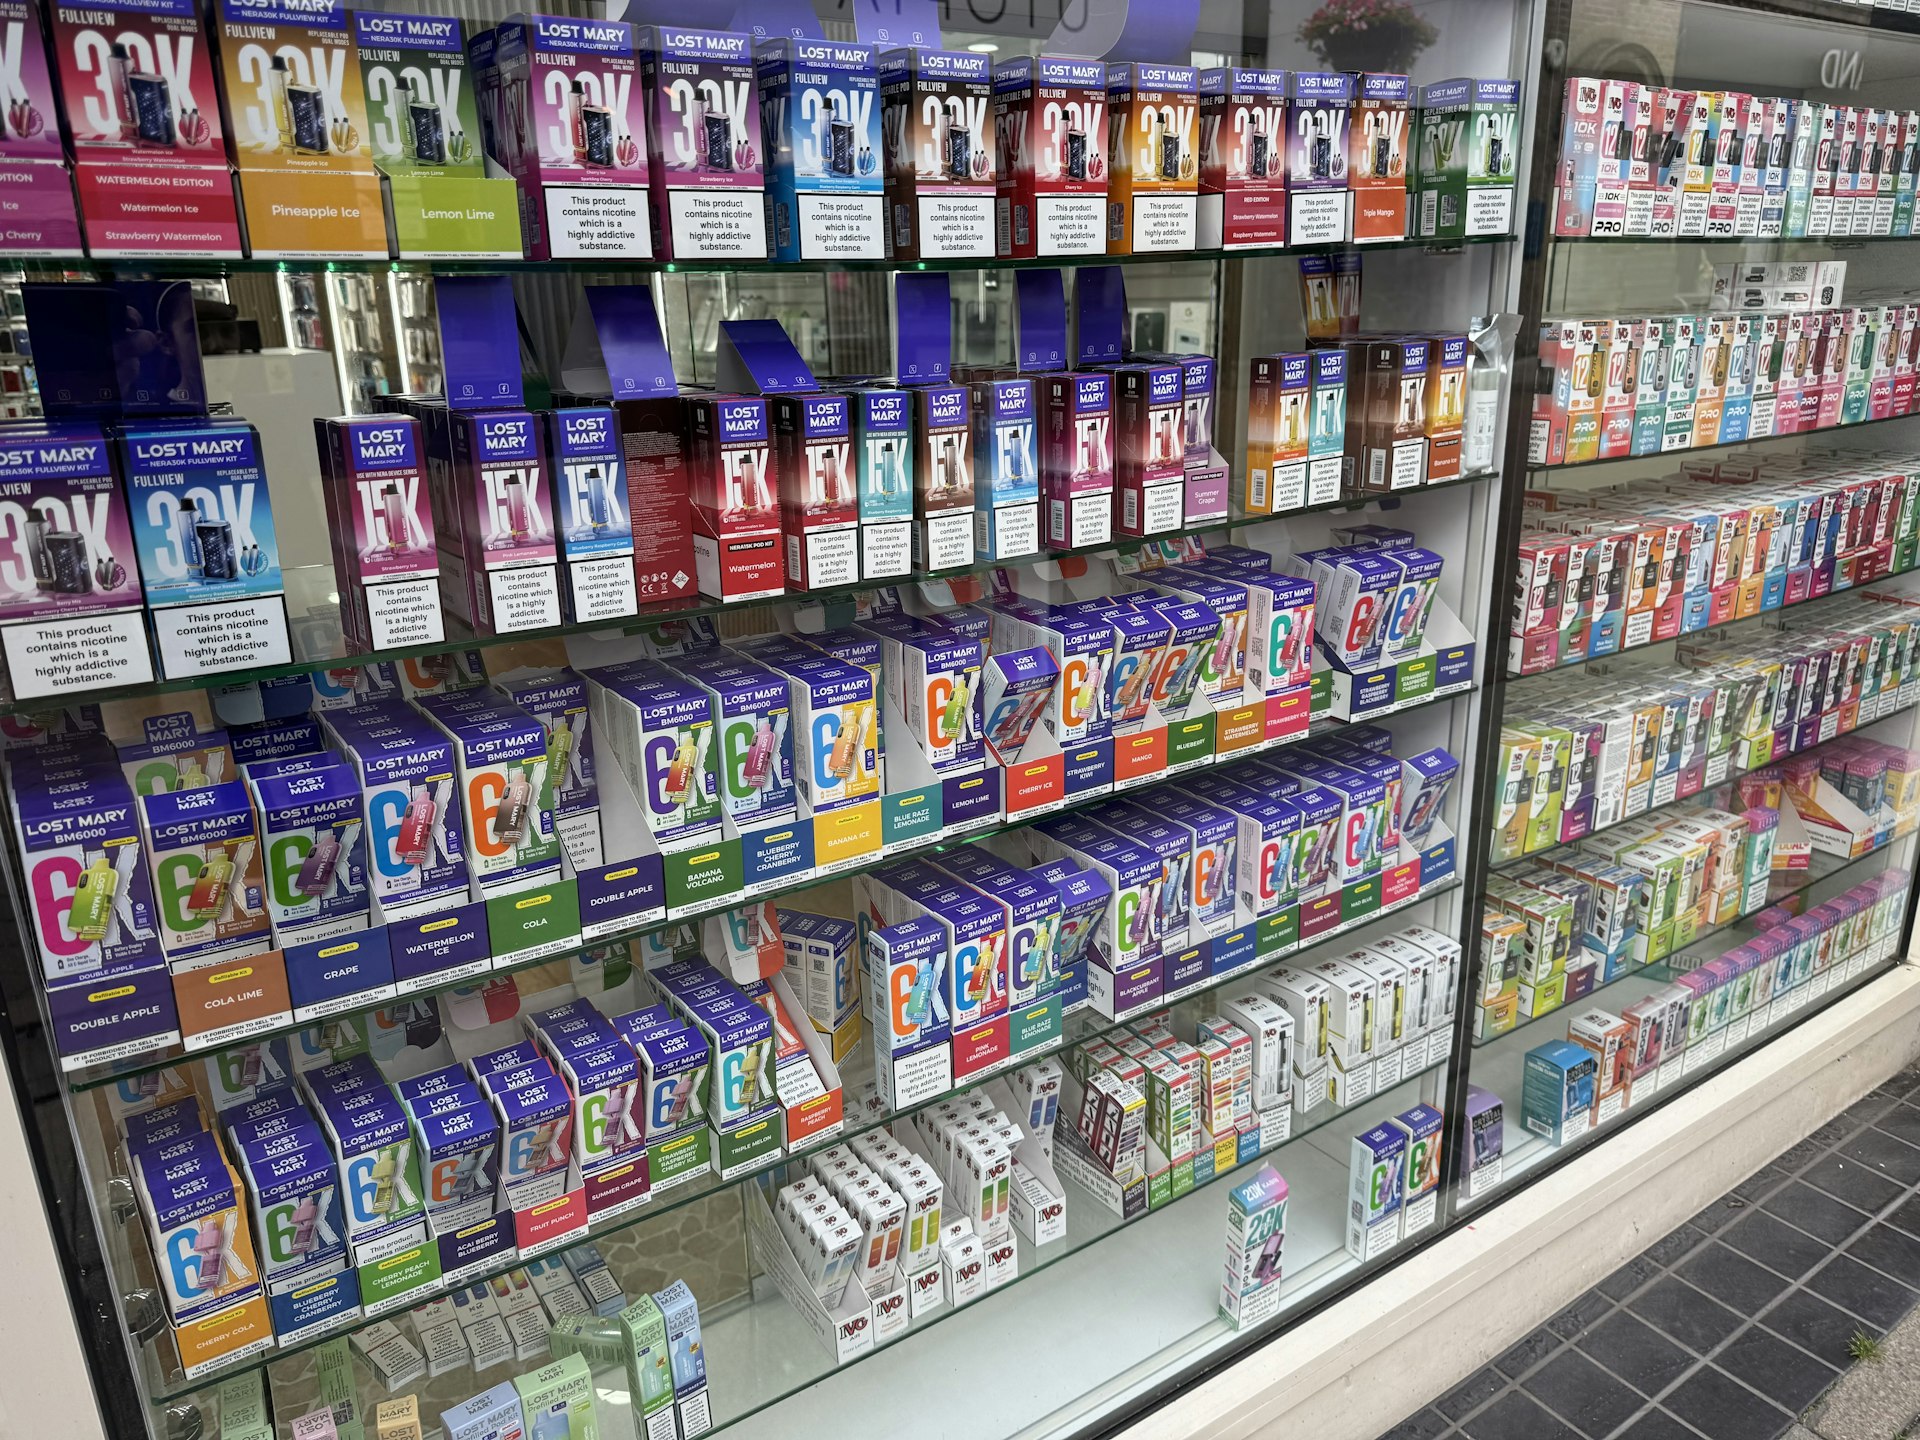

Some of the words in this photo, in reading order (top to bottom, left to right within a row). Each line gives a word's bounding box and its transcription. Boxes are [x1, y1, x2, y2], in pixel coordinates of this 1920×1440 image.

[59, 9, 115, 26] FULLVIEW
[151, 16, 182, 25] REPLACEABLE
[242, 10, 278, 19] NERA30K
[279, 13, 313, 22] FULLVIEW
[315, 15, 329, 23] KIT
[181, 25, 198, 33] MODES
[539, 22, 579, 38] LOST
[583, 27, 625, 43] MARY
[549, 40, 577, 48] NERA30K
[579, 42, 607, 50] FULLVIEW
[666, 34, 703, 49] LOST
[707, 38, 744, 52] MARY
[1043, 65, 1070, 78] LOST
[1074, 66, 1100, 78] MARY
[1235, 73, 1257, 83] LOST
[1259, 75, 1281, 85] MARY
[1427, 88, 1446, 98] LOST
[1448, 86, 1467, 96] MARY
[1574, 122, 1597, 134] 10K
[96, 176, 170, 187] WATERMELON
[172, 178, 213, 188] EDITION
[121, 202, 182, 214] Watermelon
[184, 204, 199, 214] Ice
[272, 205, 338, 218] Pineapple
[341, 206, 360, 218] Ice
[422, 208, 462, 220] Lemon
[466, 209, 495, 220] Lime
[1364, 208, 1376, 218] Triple
[1378, 208, 1395, 217] Mango
[1233, 213, 1254, 221] Strawberry
[1254, 213, 1278, 221] Watermelon
[1595, 222, 1622, 232] PRO
[1285, 361, 1306, 370] LOST
[1284, 369, 1306, 380] MARY
[1849, 390, 1866, 398] PRO
[870, 398, 902, 410] LOST
[1780, 401, 1798, 410] PRO
[724, 407, 759, 420] LOST
[870, 409, 902, 421] MARY
[566, 417, 605, 431] LOST
[725, 419, 760, 432] MARY
[1573, 421, 1597, 432] PRO
[1607, 418, 1630, 430] PRO
[567, 431, 607, 444] MARY
[137, 443, 188, 459] LOST
[192, 439, 244, 455] MARY
[1434, 458, 1448, 467] Banana
[1194, 489, 1220, 501] Summer
[1198, 496, 1216, 506] Grape
[514, 549, 538, 557] Lemonade
[729, 561, 776, 574] Watermelon
[747, 571, 759, 580] Ice
[1598, 572, 1609, 595] 12
[1567, 580, 1579, 602] 12
[37, 631, 62, 641] This
[66, 623, 112, 638] product
[26, 639, 77, 654] contains
[81, 633, 128, 648] nicotine
[50, 651, 85, 663] which
[88, 650, 97, 658] is
[102, 650, 109, 658] a
[35, 662, 71, 678] highly
[75, 658, 128, 672] addictive
[52, 671, 116, 687] substance.
[813, 685, 843, 698] LOST
[842, 678, 870, 692] MARY
[1359, 683, 1391, 696] STRAWBERRY
[1360, 689, 1390, 700] RASPBERRY
[827, 692, 857, 703] BM6000
[1359, 694, 1391, 706] BLACKBERRY
[1266, 714, 1297, 727] STRAWBERRY
[1299, 711, 1308, 719] ICE
[467, 741, 505, 756] LOST
[508, 732, 540, 748] MARY
[1176, 738, 1206, 751] BLUEBERRY
[1131, 752, 1153, 764] MANGO
[1018, 784, 1041, 795] CHERRY
[1041, 781, 1053, 791] ICE
[26, 817, 76, 836] LOST
[78, 808, 128, 827] MARY
[894, 812, 912, 822] BLUE
[913, 808, 930, 819] RAZZ
[894, 814, 930, 830] LEMONADE
[54, 827, 107, 845] BM6000
[686, 874, 724, 889] VOLCANO
[688, 868, 722, 882] BANANA
[522, 918, 548, 930] COLA
[1262, 932, 1279, 943] TRIPLE
[1280, 926, 1294, 936] BERRY
[406, 932, 475, 956] WATERMELON
[433, 945, 450, 956] ICE
[323, 964, 359, 981] GRAPE
[93, 990, 118, 1000] Refillable
[204, 996, 236, 1010] COLA
[238, 988, 264, 1003] LIME
[70, 1016, 121, 1033] DOUBLE
[122, 1004, 161, 1022] APPLE
[1020, 1025, 1037, 1036] BLUE
[1037, 1019, 1052, 1030] RAZZ
[1020, 1024, 1052, 1039] LEMONADE
[89, 1047, 127, 1059] FORBIDDEN
[138, 1038, 153, 1047] SELL
[912, 1039, 931, 1049] MENTHOL
[975, 1043, 989, 1053] PINK
[966, 1046, 999, 1063] LEMONADE
[800, 1107, 832, 1125] RASPBERRY
[807, 1114, 826, 1126] PEACH
[732, 1141, 751, 1155] TRIPLE
[752, 1134, 772, 1148] MELON
[592, 1185, 620, 1202] SUMMER
[621, 1178, 643, 1191] GRAPE
[1038, 1203, 1064, 1224] IVG
[530, 1221, 550, 1233] FRUIT
[551, 1211, 575, 1226] PUNCH
[456, 1241, 473, 1252] ACAI
[475, 1232, 498, 1246] BERRY
[457, 1238, 500, 1258] BLUEBERRY
[956, 1261, 982, 1283] IVG
[292, 1288, 340, 1309] BLUEBERRY
[302, 1298, 333, 1312] CHERRY
[876, 1294, 904, 1317] IVG
[294, 1300, 343, 1322] CRANBERRY
[623, 1300, 648, 1318] LOST
[627, 1304, 653, 1324] MARY
[196, 1330, 229, 1349] CHERRY
[231, 1322, 255, 1336] COLA
[839, 1317, 869, 1341] IVG
[849, 1332, 861, 1342] AIR
[538, 1365, 562, 1378] LOST
[540, 1369, 565, 1384] MARY
[526, 1387, 557, 1406] LOST
[558, 1376, 587, 1393] MARY
[528, 1400, 559, 1413] Prefilled
[561, 1391, 574, 1401] Pod
[575, 1384, 588, 1395] Kit
